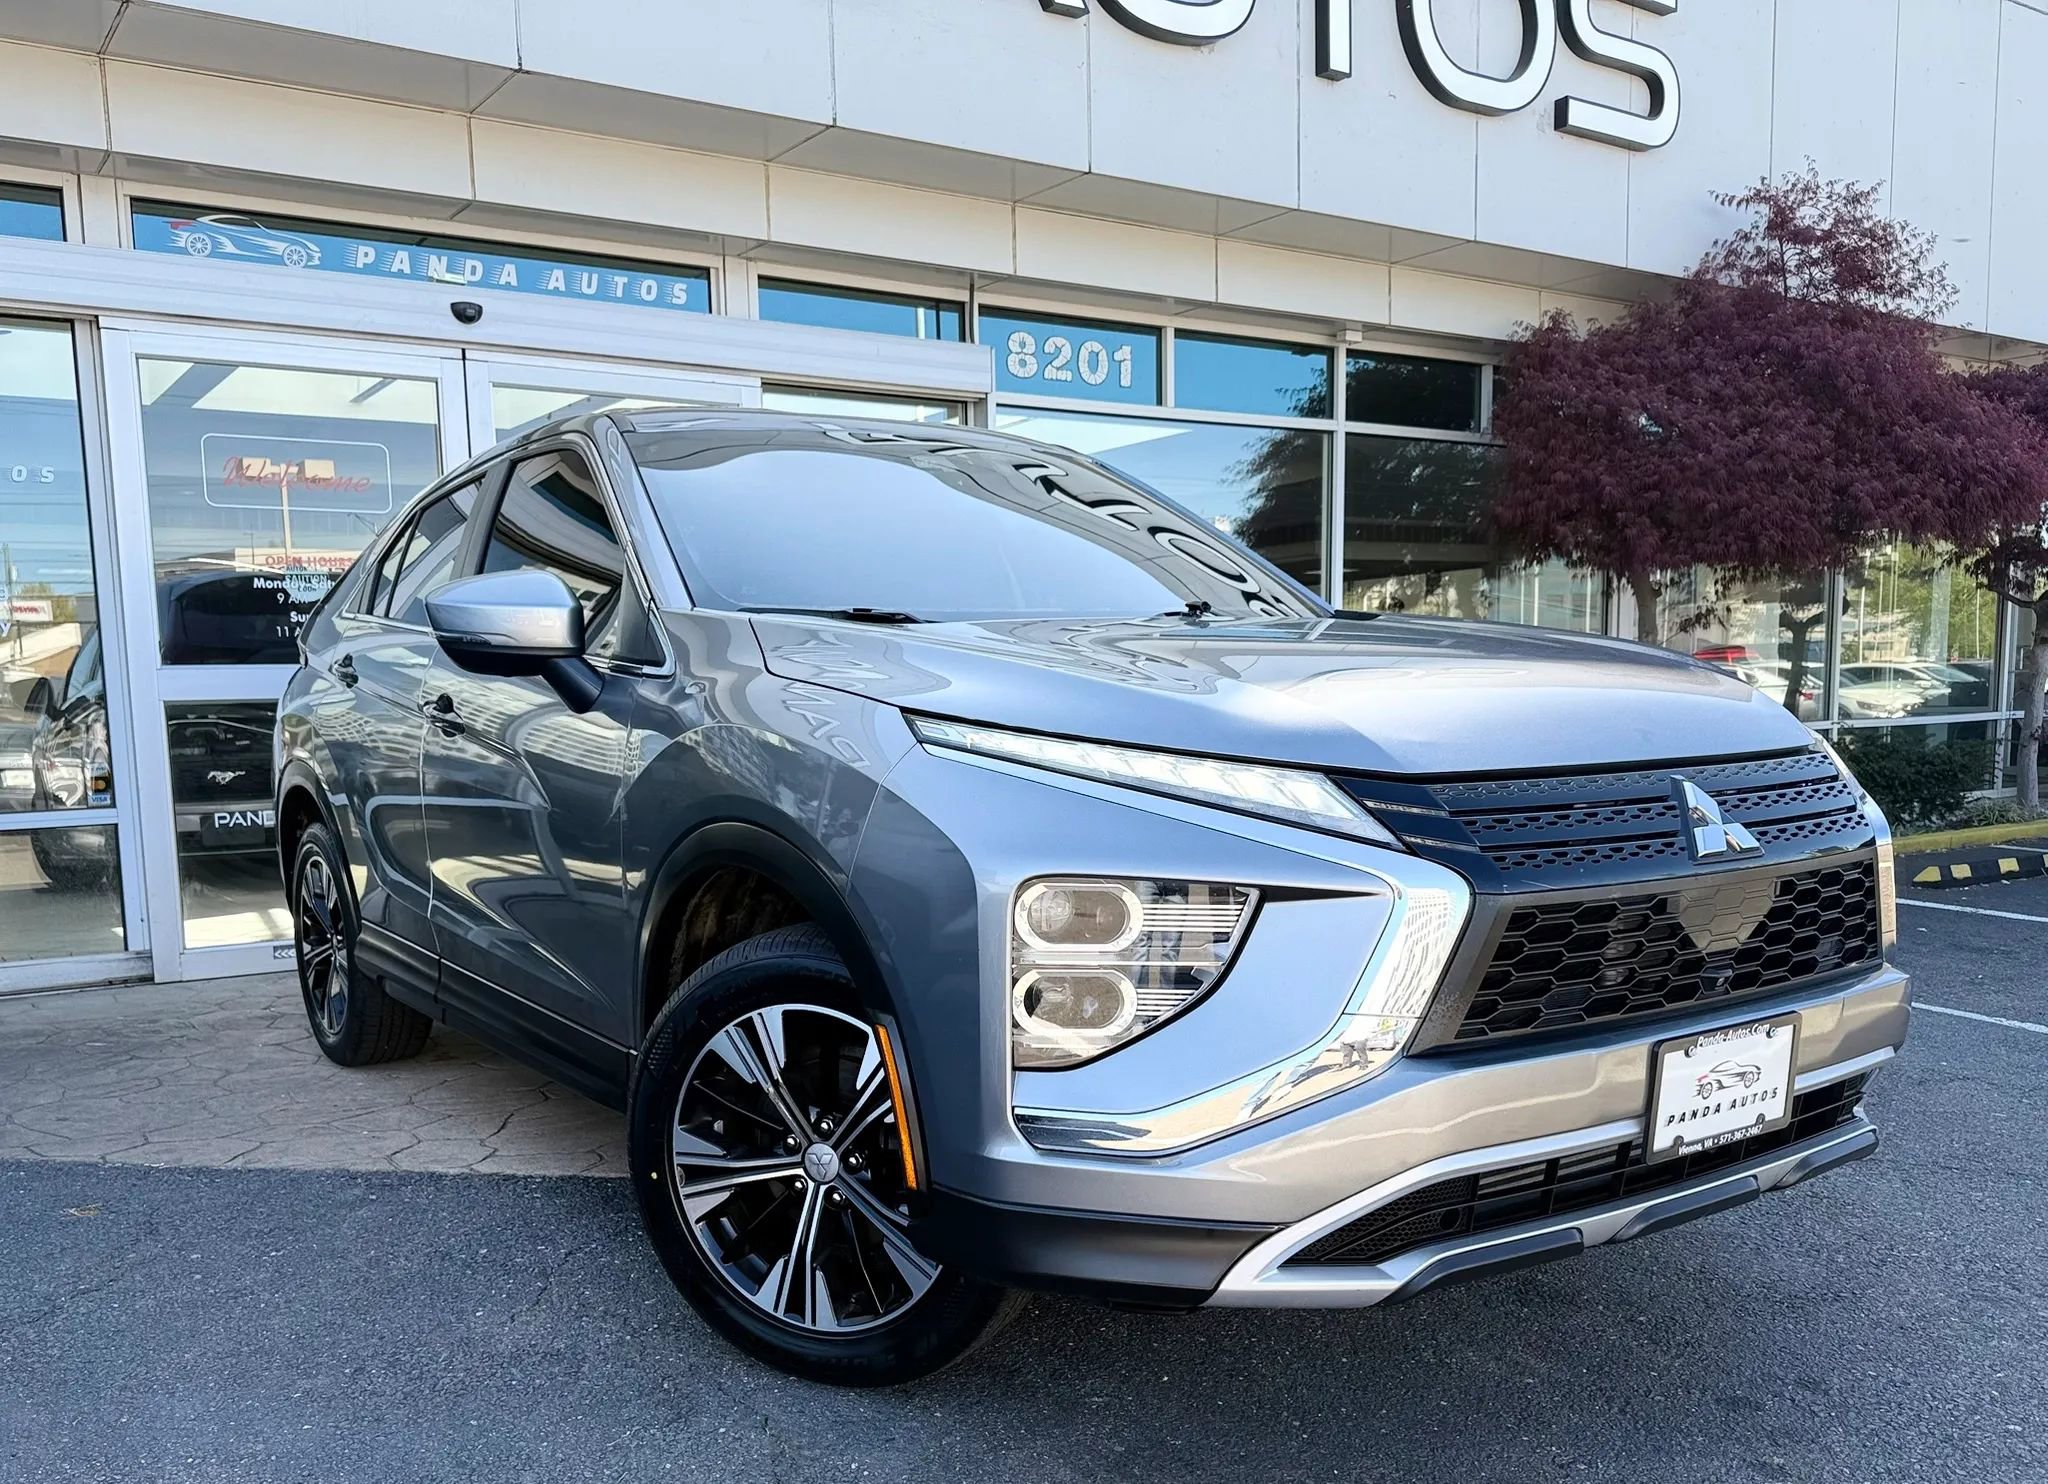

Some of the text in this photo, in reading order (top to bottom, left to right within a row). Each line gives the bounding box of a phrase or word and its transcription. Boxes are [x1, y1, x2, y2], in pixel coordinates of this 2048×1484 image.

[347, 244, 688, 306] PANDA AUTOS
[1007, 331, 1132, 388] 8201
[265, 555, 302, 568] OPEN
[277, 592, 285, 604] 9
[214, 809, 276, 829] PAND
[1665, 1087, 1778, 1127] PANDA AUTOS
